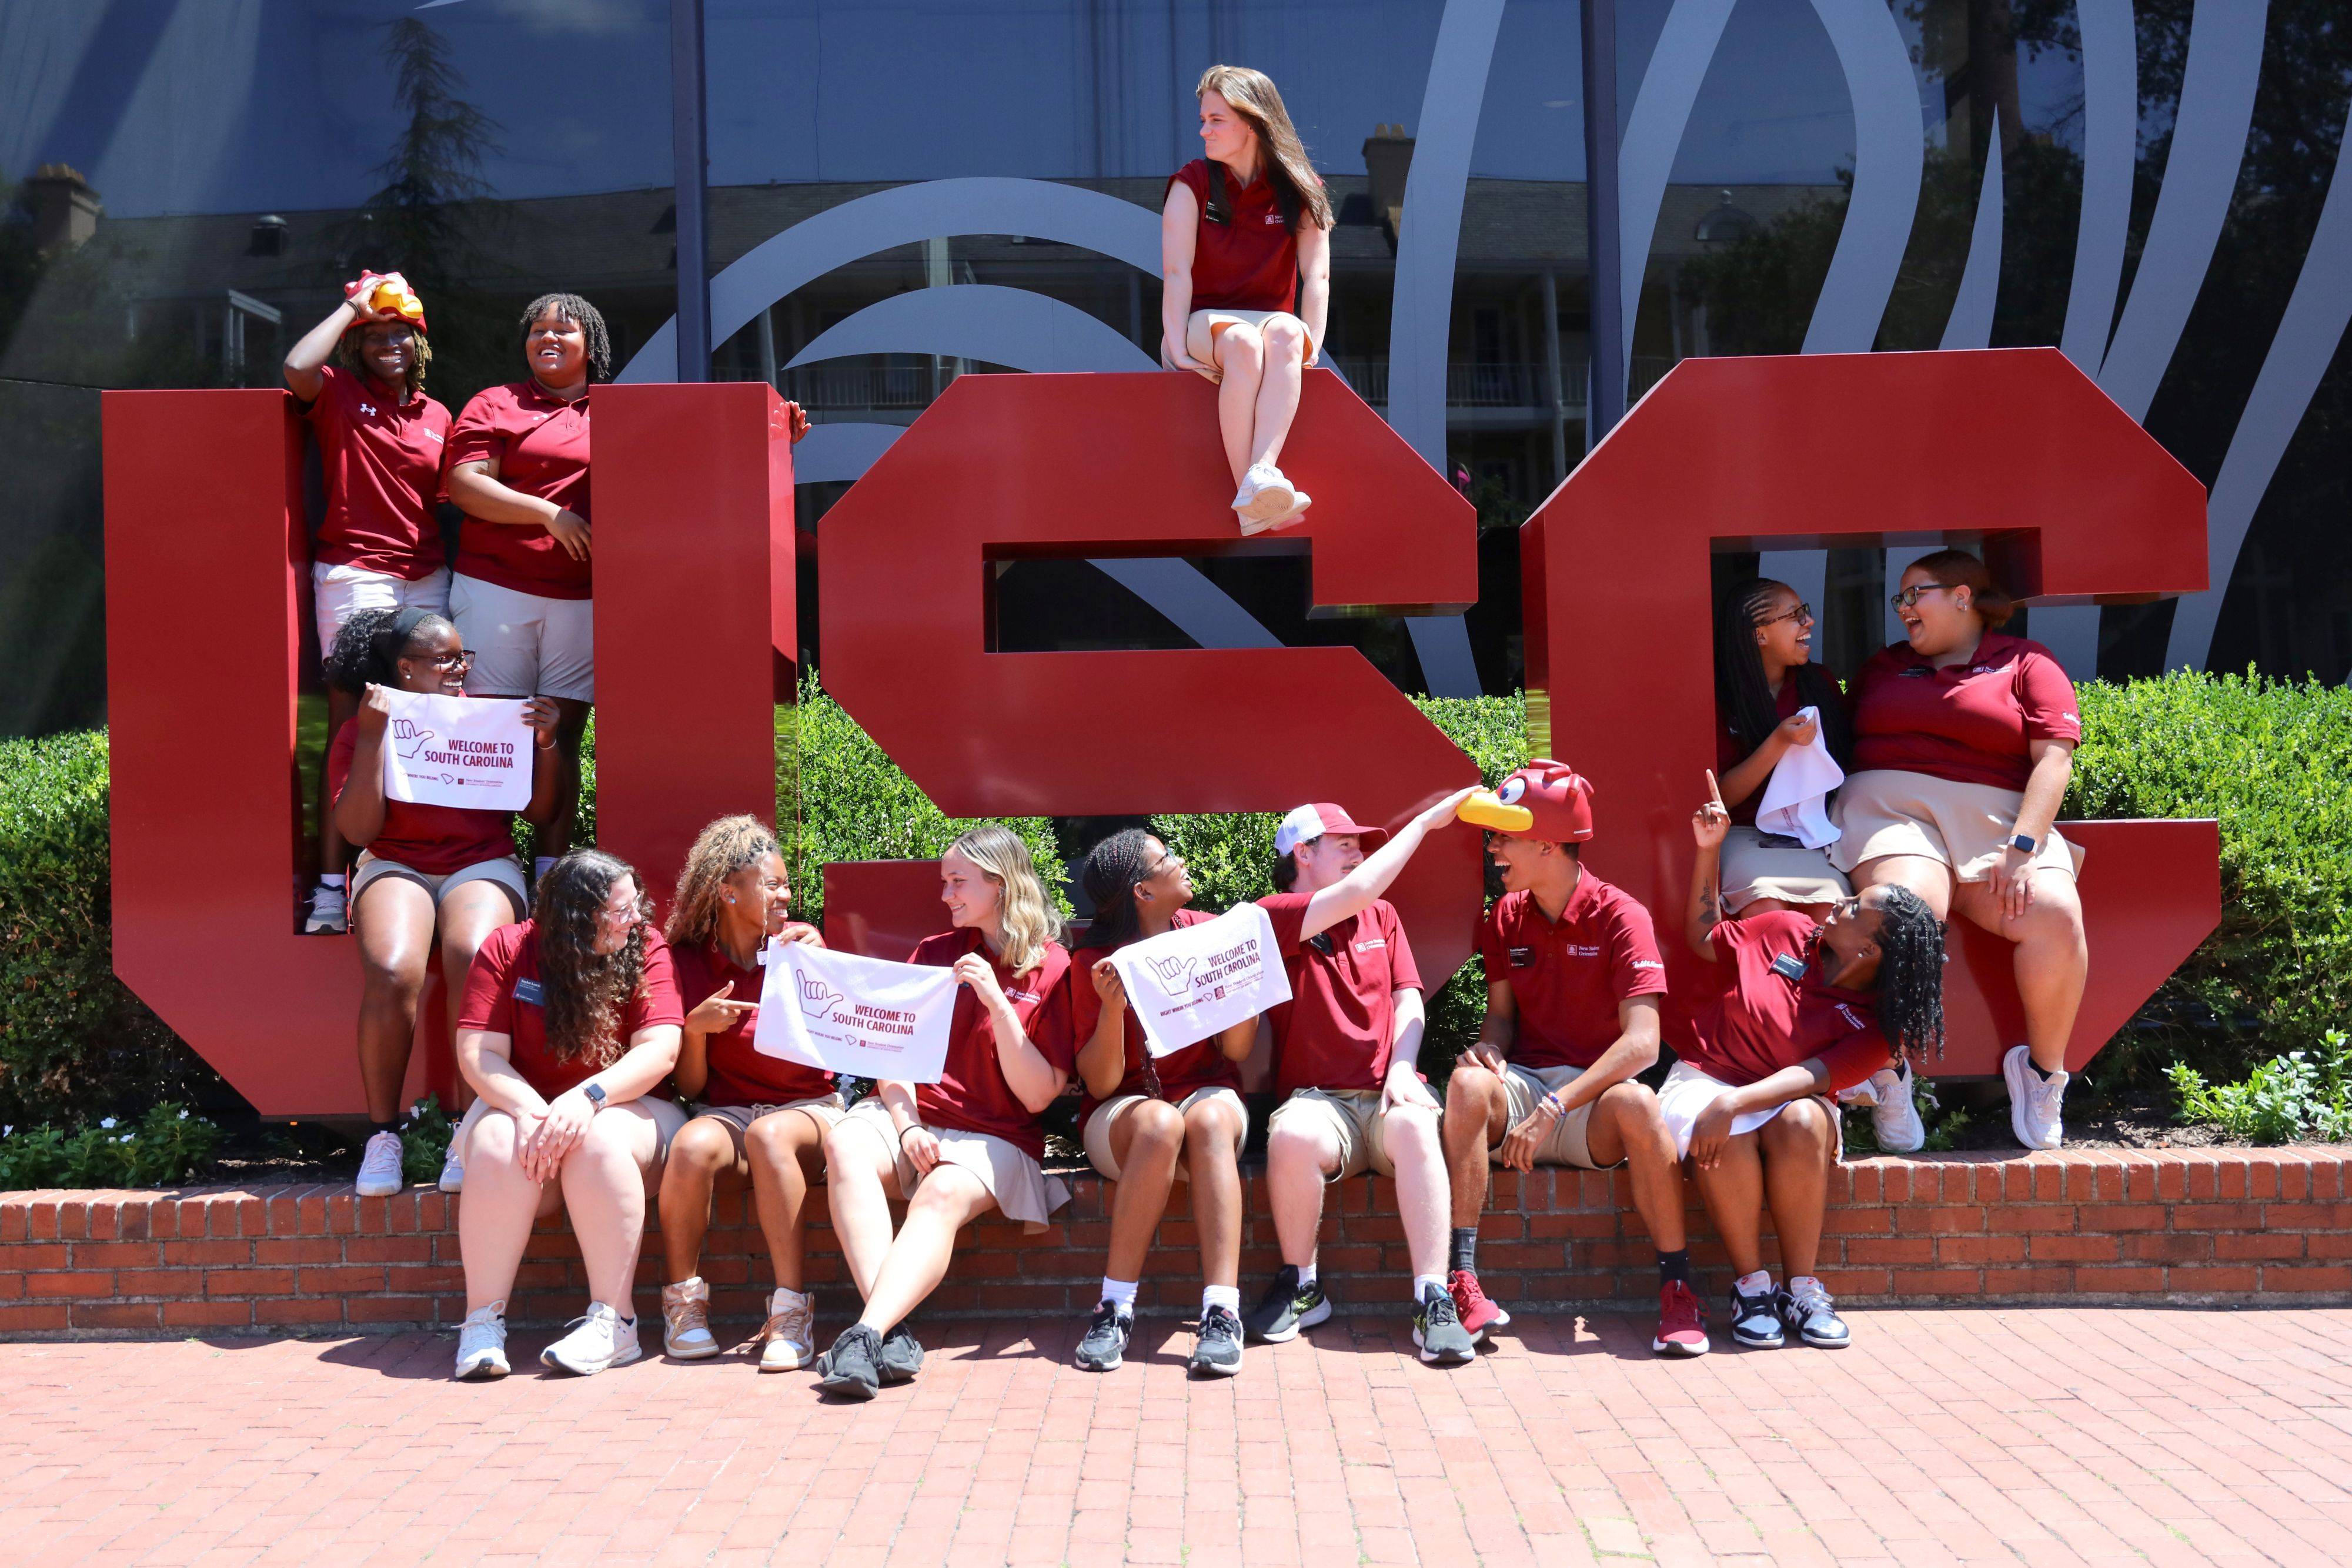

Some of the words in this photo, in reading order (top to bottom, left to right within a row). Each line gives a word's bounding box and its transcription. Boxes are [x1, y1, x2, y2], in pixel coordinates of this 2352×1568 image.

[449, 739, 498, 754] WELCOME
[501, 743, 514, 754] TO
[425, 750, 460, 765] SOUTH
[463, 755, 513, 768] CAROLINA
[1208, 942, 1245, 968] WELCOME
[1245, 939, 1257, 952] TO
[1195, 968, 1223, 988] SOUTH
[1224, 952, 1261, 976] CAROLINA
[833, 1012, 864, 1028] SOUTH
[867, 1020, 914, 1035] CAROLINA
[855, 1004, 901, 1022] WELCOME
[904, 1012, 916, 1023] TO
